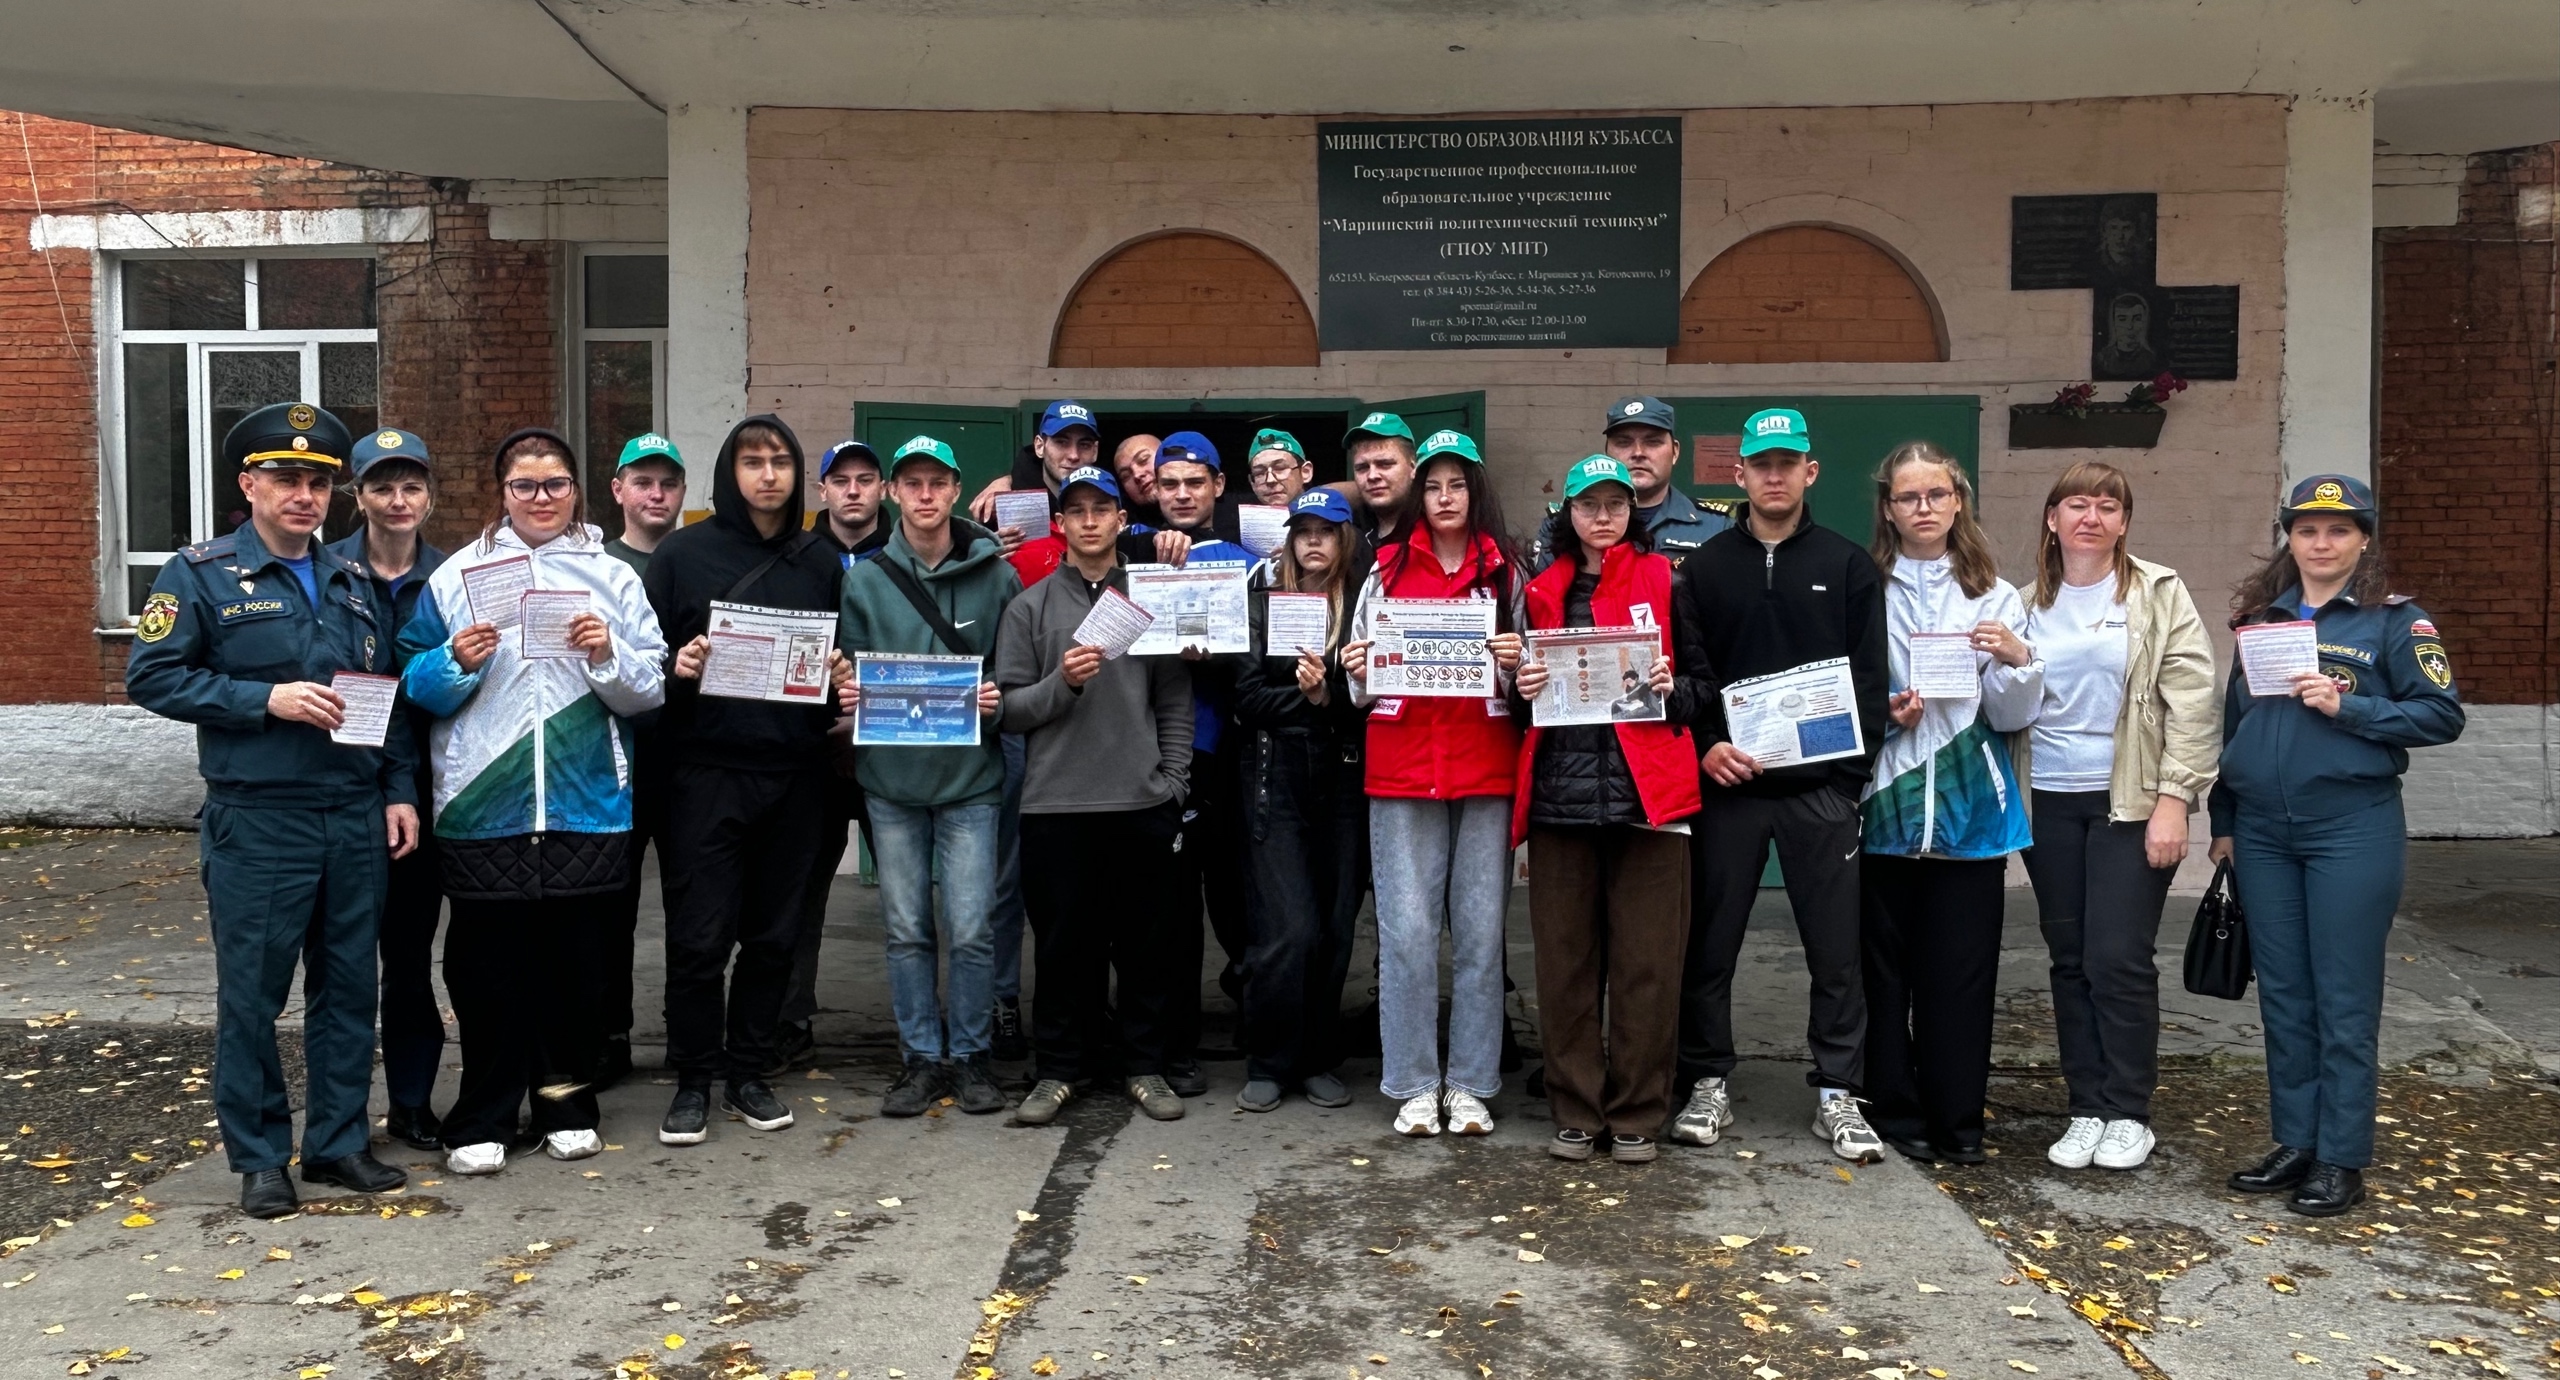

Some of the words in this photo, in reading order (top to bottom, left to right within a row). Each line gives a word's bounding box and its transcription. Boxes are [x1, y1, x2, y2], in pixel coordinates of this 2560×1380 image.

[1325, 132, 1462, 150] МИНИСТЕРСТВО
[1466, 130, 1584, 148] ОБРАЗОВАНИЯ
[1588, 128, 1674, 146] КУЗБАССА
[1354, 165, 1484, 181] Государственное
[1489, 163, 1637, 179] профессиональное
[1382, 191, 1513, 207] образовательное
[1518, 191, 1612, 205] учреждение
[1439, 214, 1578, 230] политехнический
[1440, 242, 1496, 259] (ГПОУ
[1500, 241, 1548, 257] МПТ)
[1659, 268, 1671, 278] 19
[1756, 415, 1792, 434] МПТ
[222, 604, 241, 617] МЧС
[244, 601, 283, 612] РОССИИ
